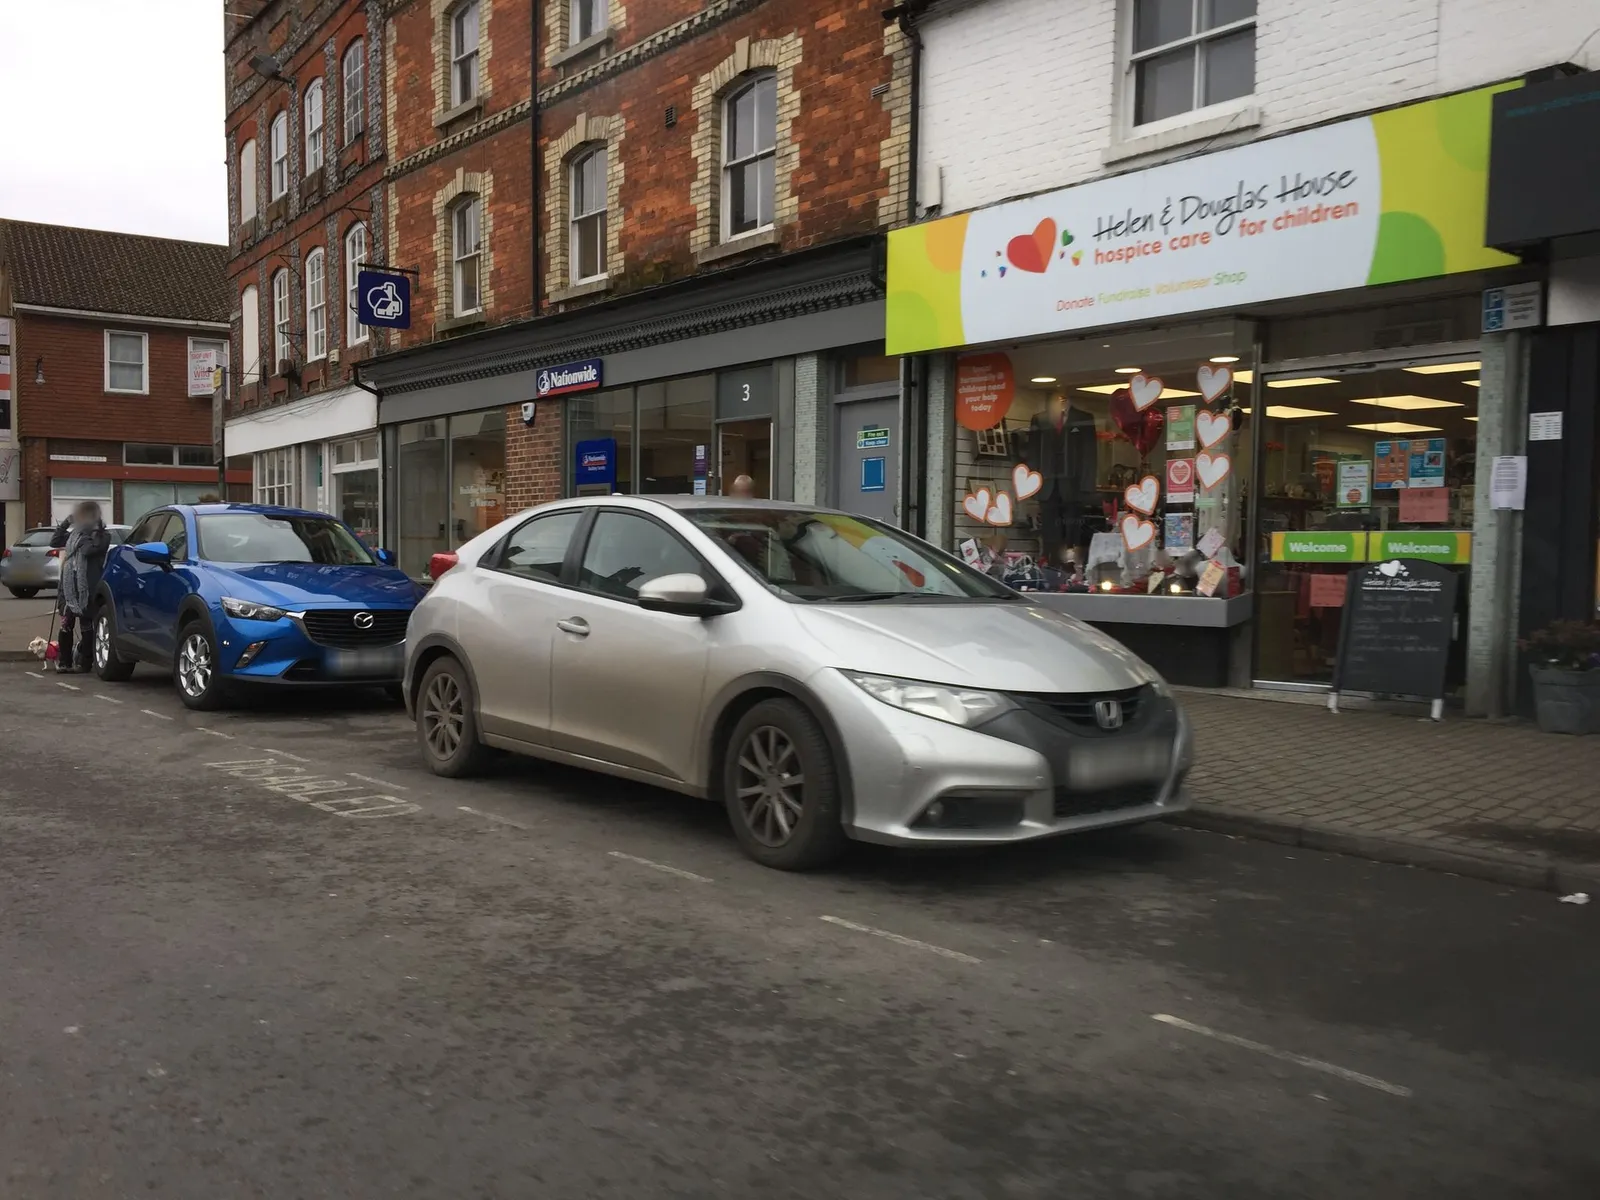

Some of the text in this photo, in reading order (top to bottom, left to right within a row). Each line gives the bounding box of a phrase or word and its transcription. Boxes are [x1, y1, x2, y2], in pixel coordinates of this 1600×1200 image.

[1092, 169, 1359, 242] Helen & Douglas House
[1094, 201, 1359, 265] hospice care for children
[1056, 270, 1248, 312] Donate Fundraise Volunteer Shop
[550, 365, 597, 388] Nationwide
[742, 384, 750, 401] 3
[1289, 542, 1347, 553] Welcome
[1388, 542, 1450, 553] Welcome
[201, 758, 423, 819] DISABLED
